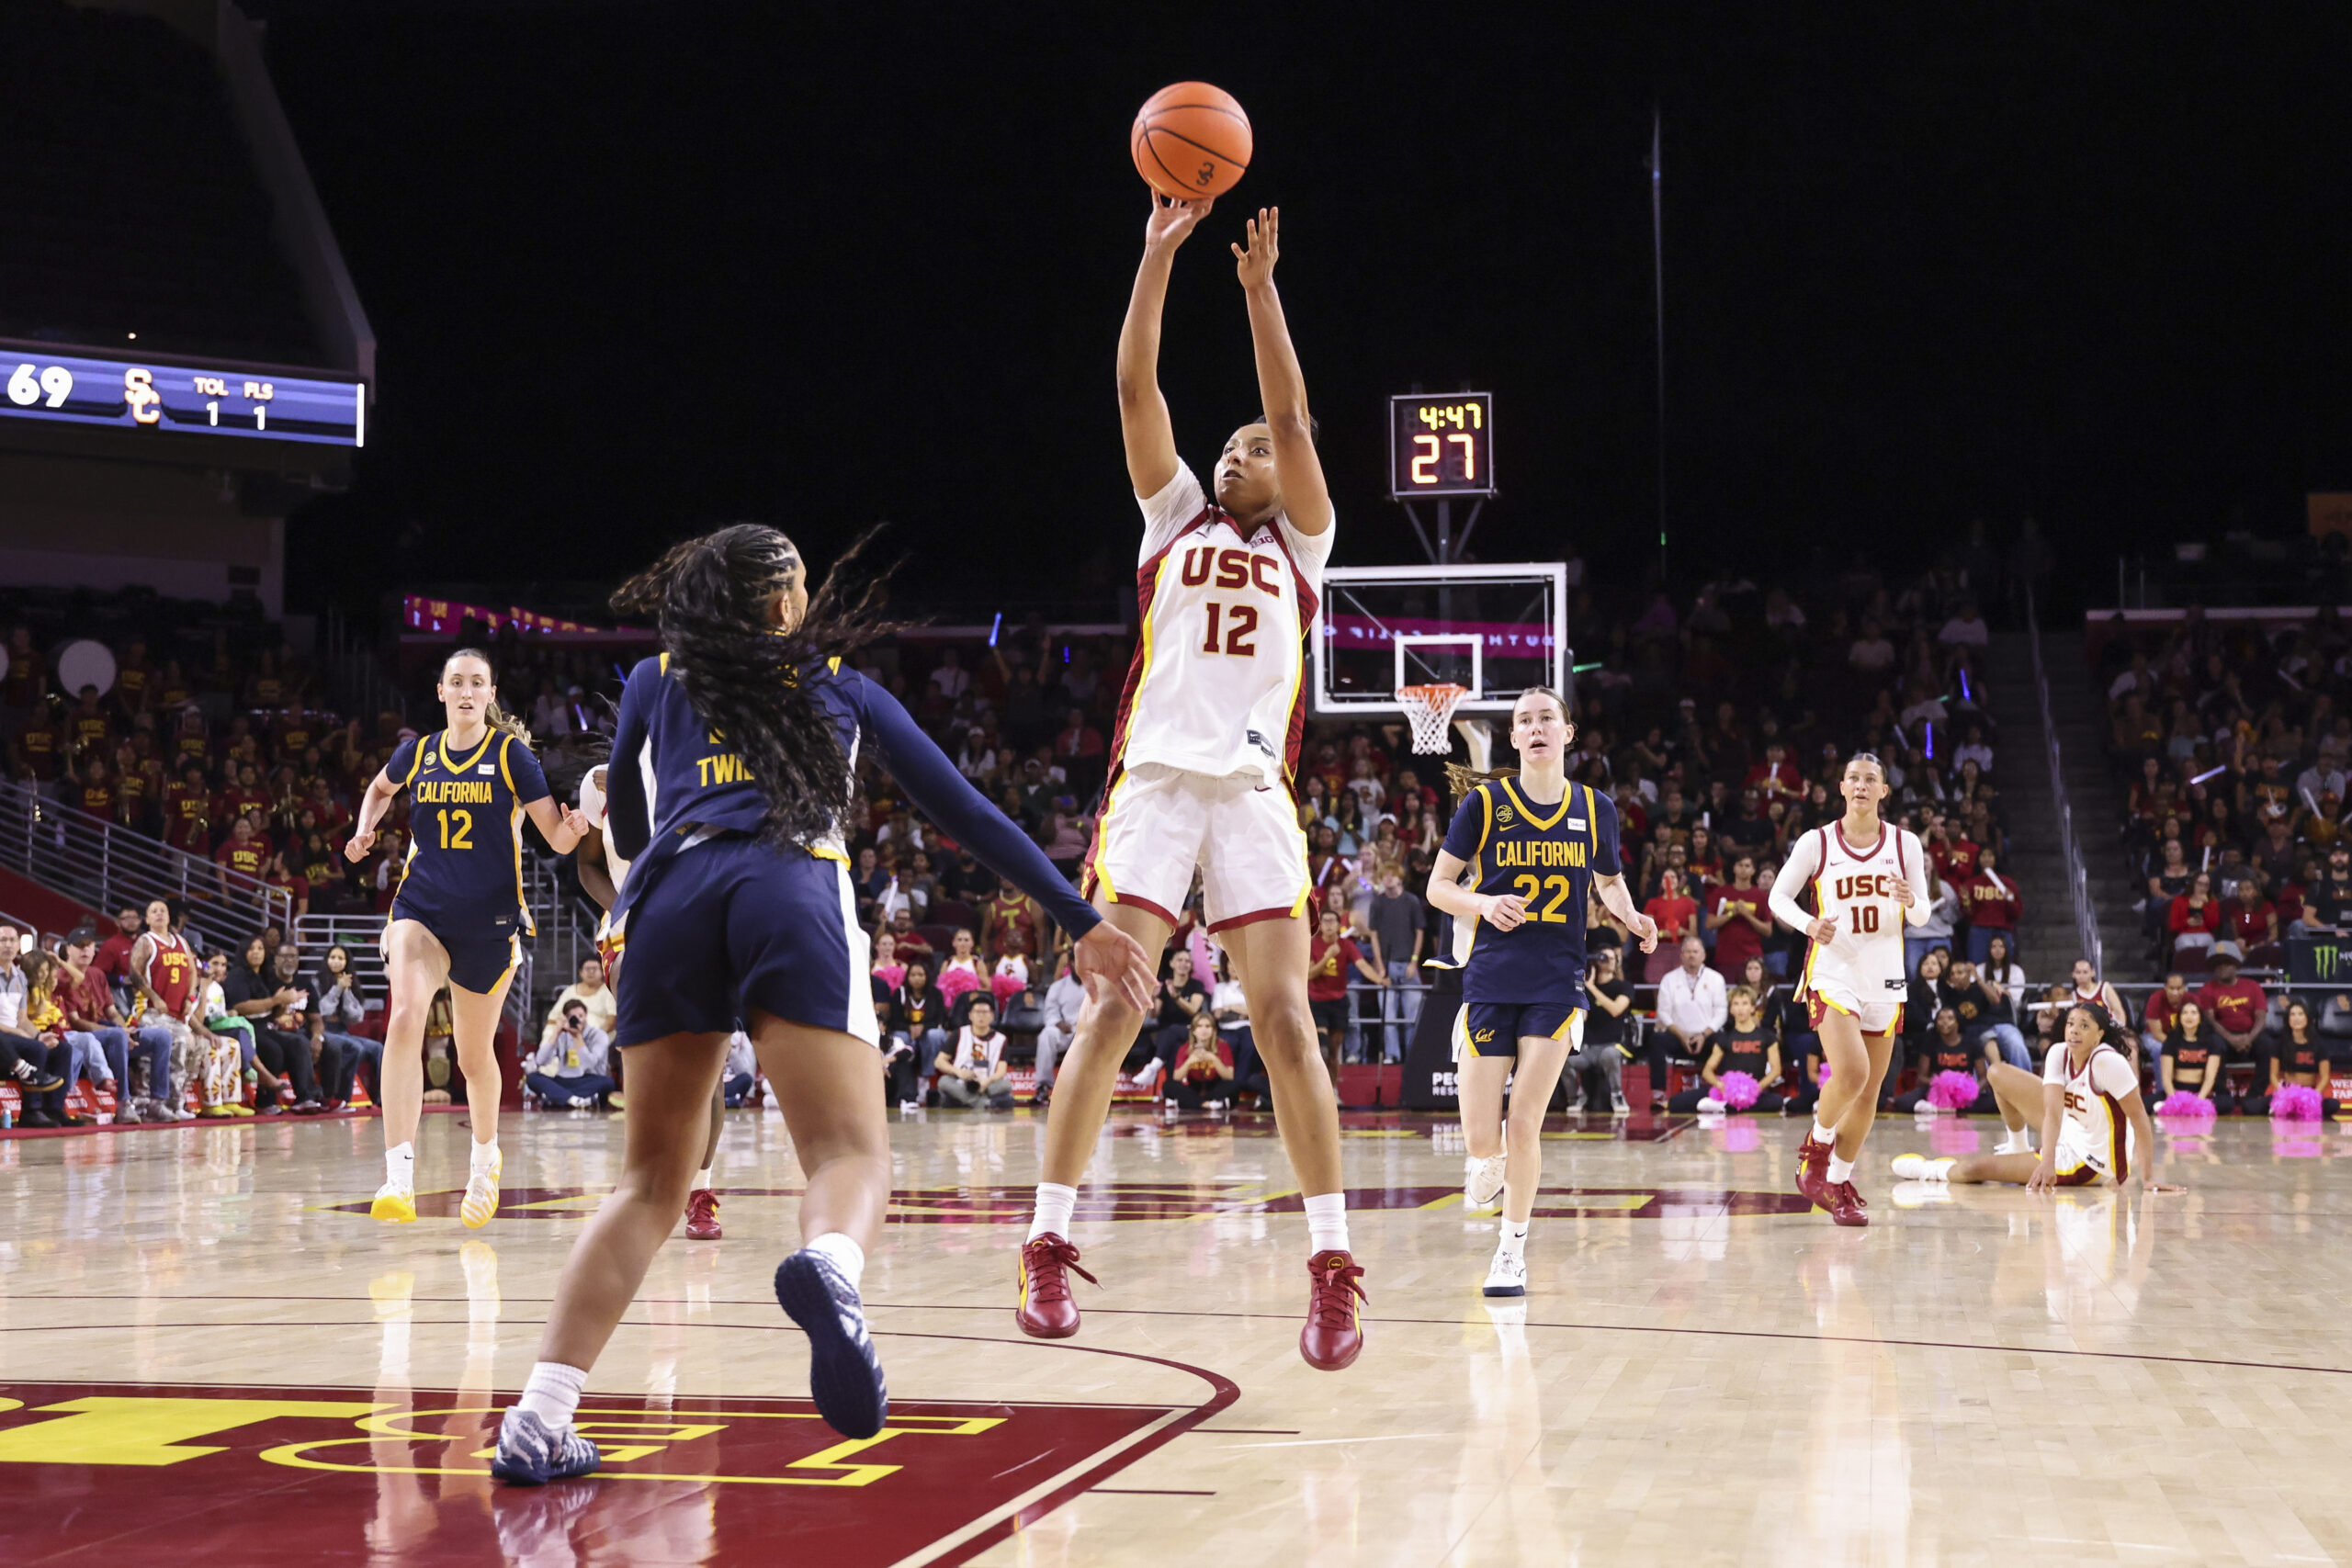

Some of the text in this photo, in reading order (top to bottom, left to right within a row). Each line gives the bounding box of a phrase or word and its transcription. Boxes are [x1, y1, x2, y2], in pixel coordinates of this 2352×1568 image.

[7, 364, 73, 408] 69
[193, 378, 274, 400] TOL FLS
[207, 401, 266, 430] 1 1
[1419, 403, 1481, 430] 4:47
[1412, 434, 1474, 483] 27
[1182, 547, 1280, 599] USC
[1203, 603, 1258, 657] 12
[417, 782, 492, 804] CALIFORNIA
[437, 809, 472, 850] 12
[1496, 841, 1586, 868] CALIFORNIA
[1513, 874, 1570, 923] 22
[1836, 875, 1890, 900] USC
[1850, 905, 1879, 934] 10
[162, 952, 188, 967] USC
[170, 967, 179, 984] 9
[1475, 1028, 1496, 1043] Cal
[2064, 1092, 2086, 1112] SC
